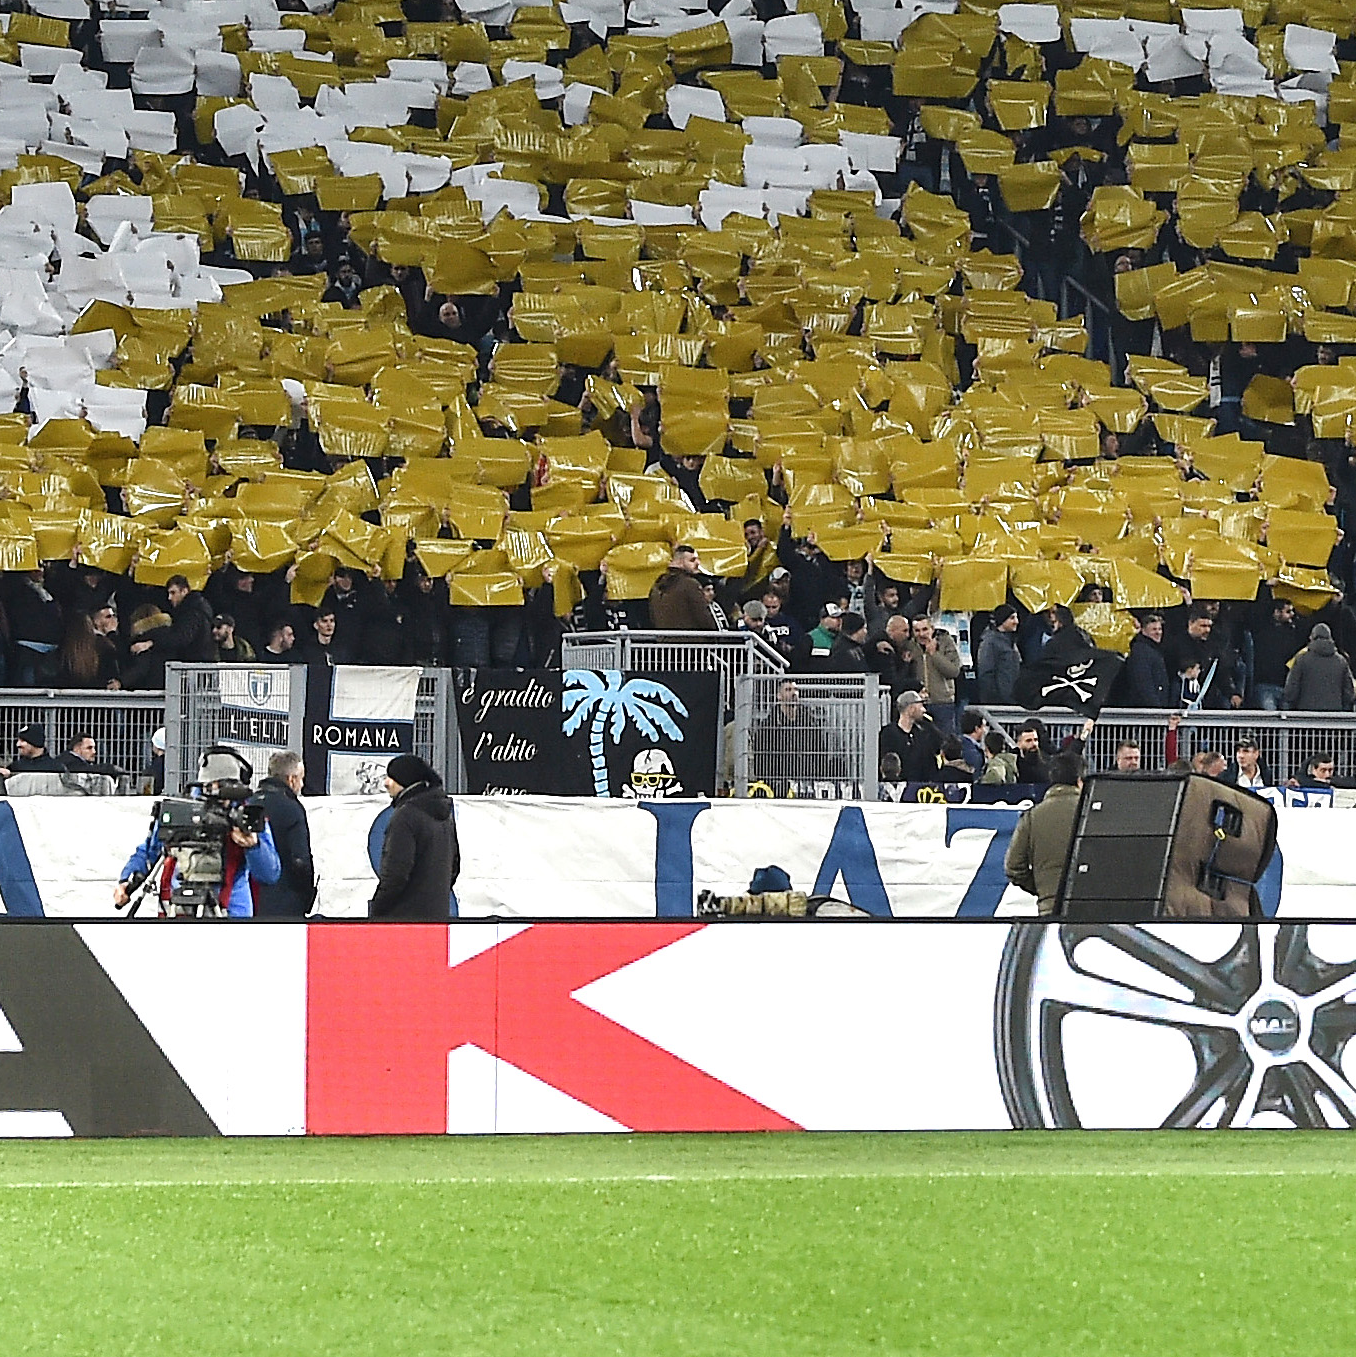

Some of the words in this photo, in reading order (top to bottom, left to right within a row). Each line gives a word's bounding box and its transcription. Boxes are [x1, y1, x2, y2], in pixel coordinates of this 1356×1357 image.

[474, 678, 555, 723] gradito
[230, 714, 289, 741] L'ELIT
[312, 724, 401, 748] ROMANA
[473, 731, 537, 761] l'abito
